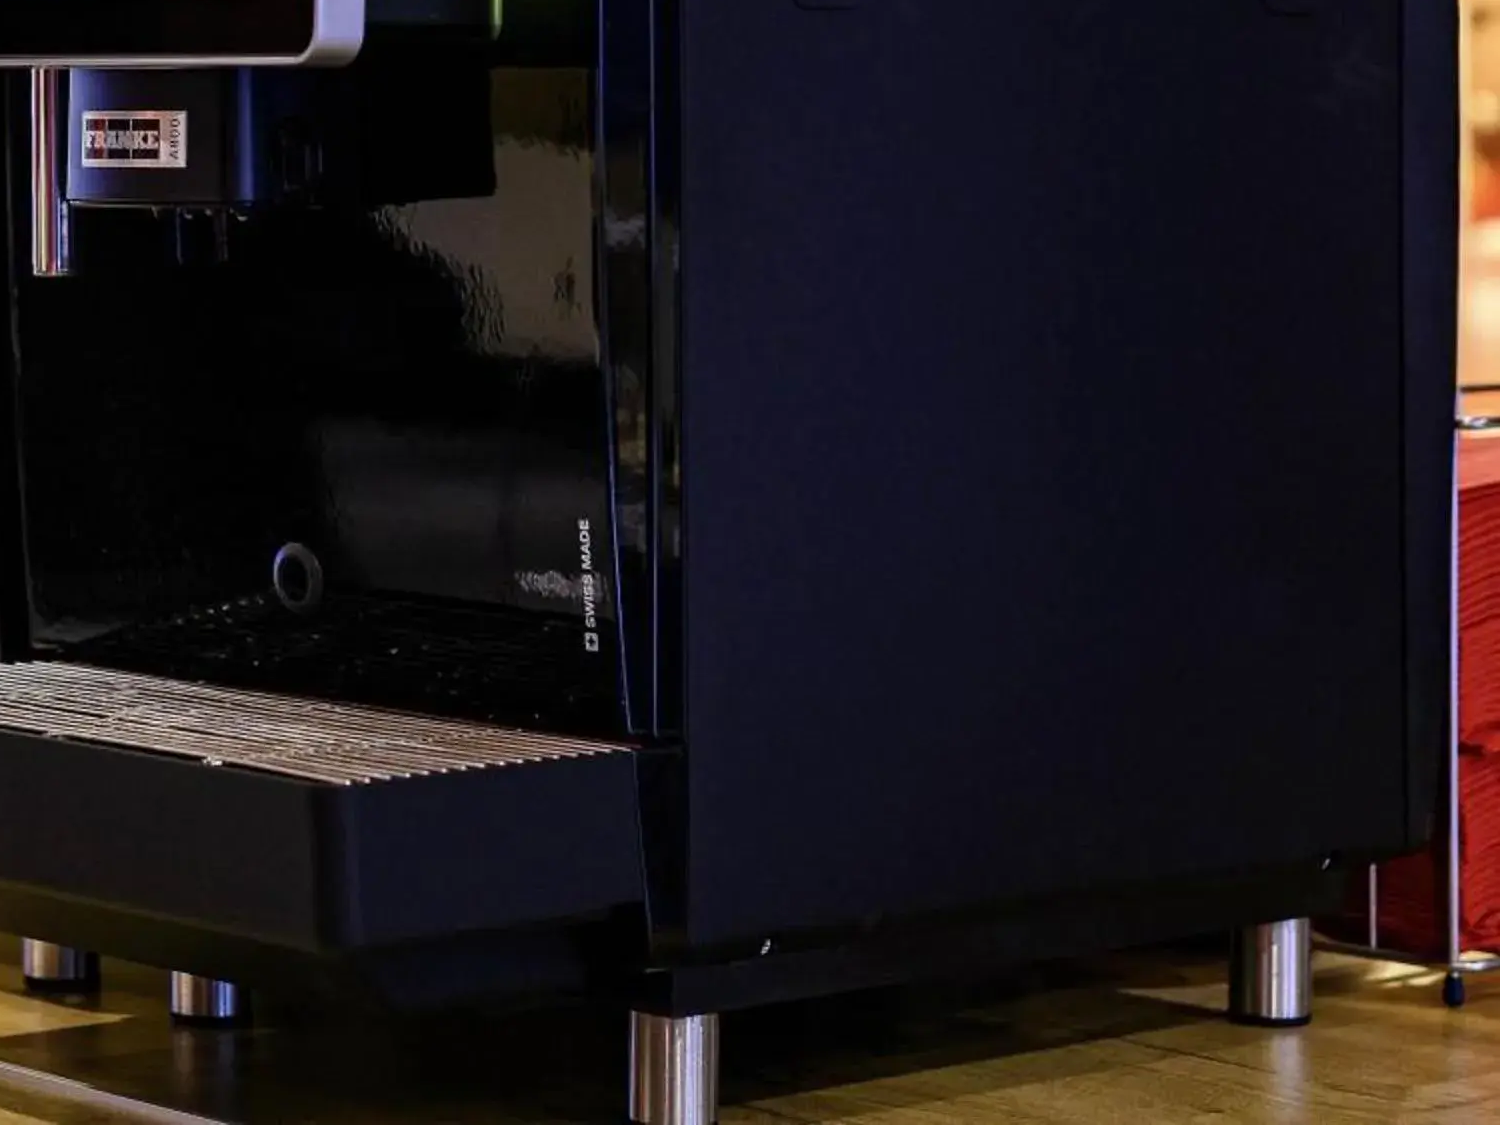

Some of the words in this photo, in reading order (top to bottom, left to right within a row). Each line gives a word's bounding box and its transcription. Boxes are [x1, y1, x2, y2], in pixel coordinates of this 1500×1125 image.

[84, 129, 160, 150] FRANKE
[169, 117, 181, 160] A800
[579, 518, 592, 570] MADE
[581, 574, 597, 628] SWISS
